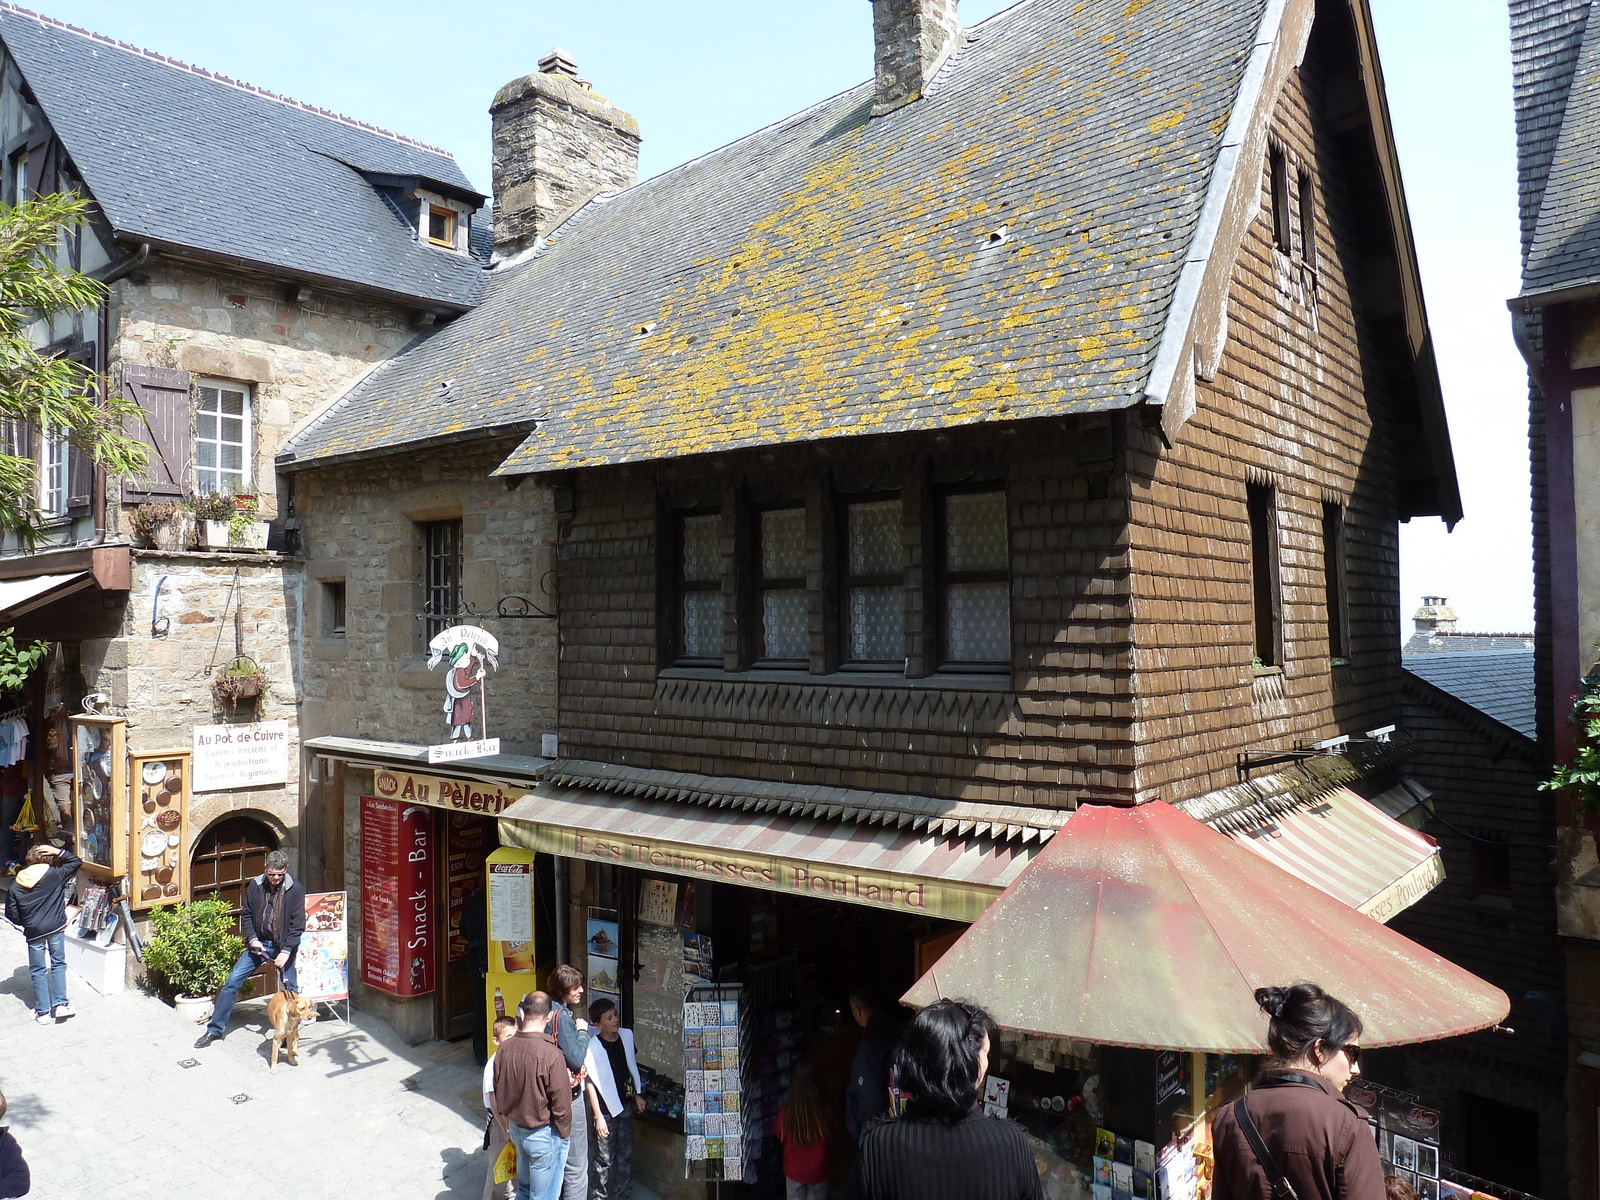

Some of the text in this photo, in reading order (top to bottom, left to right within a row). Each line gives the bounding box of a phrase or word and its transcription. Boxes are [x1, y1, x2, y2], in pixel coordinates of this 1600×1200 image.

[198, 730, 284, 746] Au Pot de Cuivre
[378, 776, 517, 815] SNACK Au Pèlerin
[408, 828, 426, 862] Bar
[578, 836, 925, 910] Les Terrasses Poulard
[1395, 864, 1436, 906] Poulard
[407, 889, 427, 949] Snack
